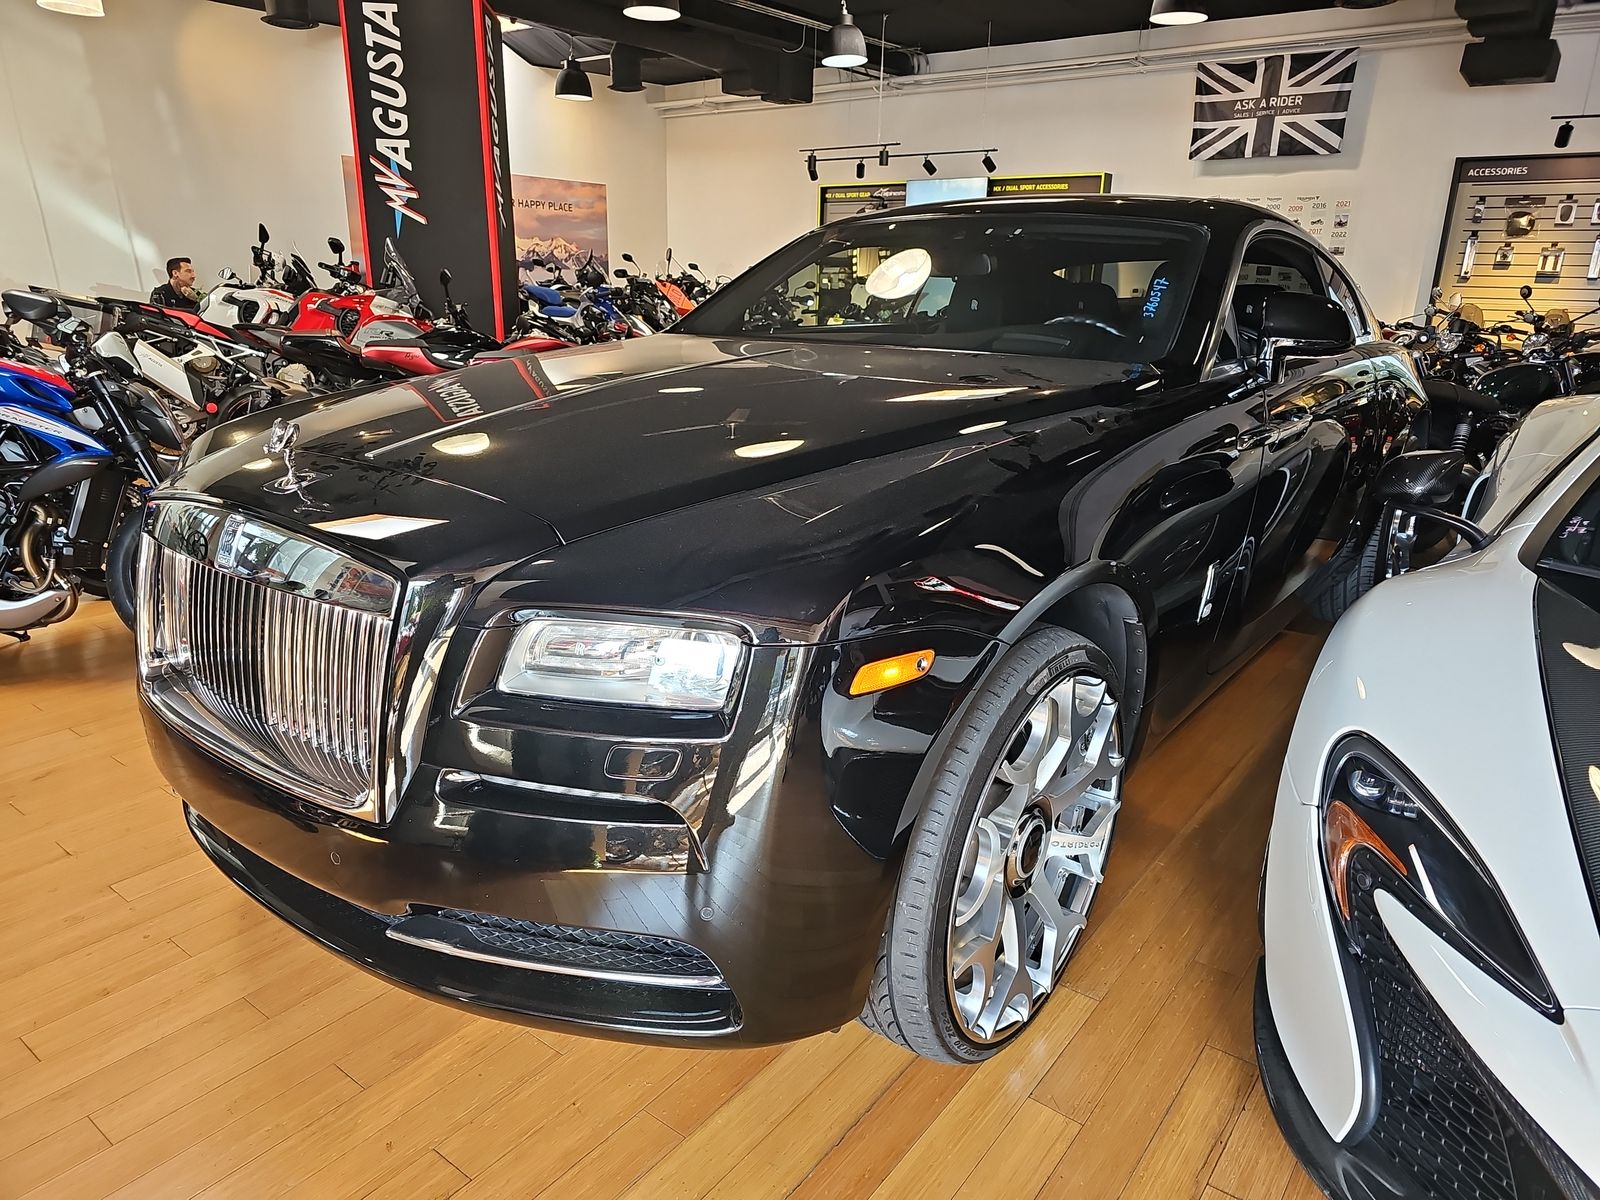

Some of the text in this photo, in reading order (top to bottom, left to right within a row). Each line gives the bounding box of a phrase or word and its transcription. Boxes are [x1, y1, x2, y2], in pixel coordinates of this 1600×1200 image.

[361, 1, 412, 171] AGUSTA
[1234, 95, 1303, 111] ASK A RIDER
[1255, 109, 1275, 117] SERVICE
[1467, 166, 1528, 177] ACCESSORIES
[517, 199, 546, 210] HAPPY
[548, 201, 573, 212] PLACE
[1047, 655, 1071, 677] PIRELLI
